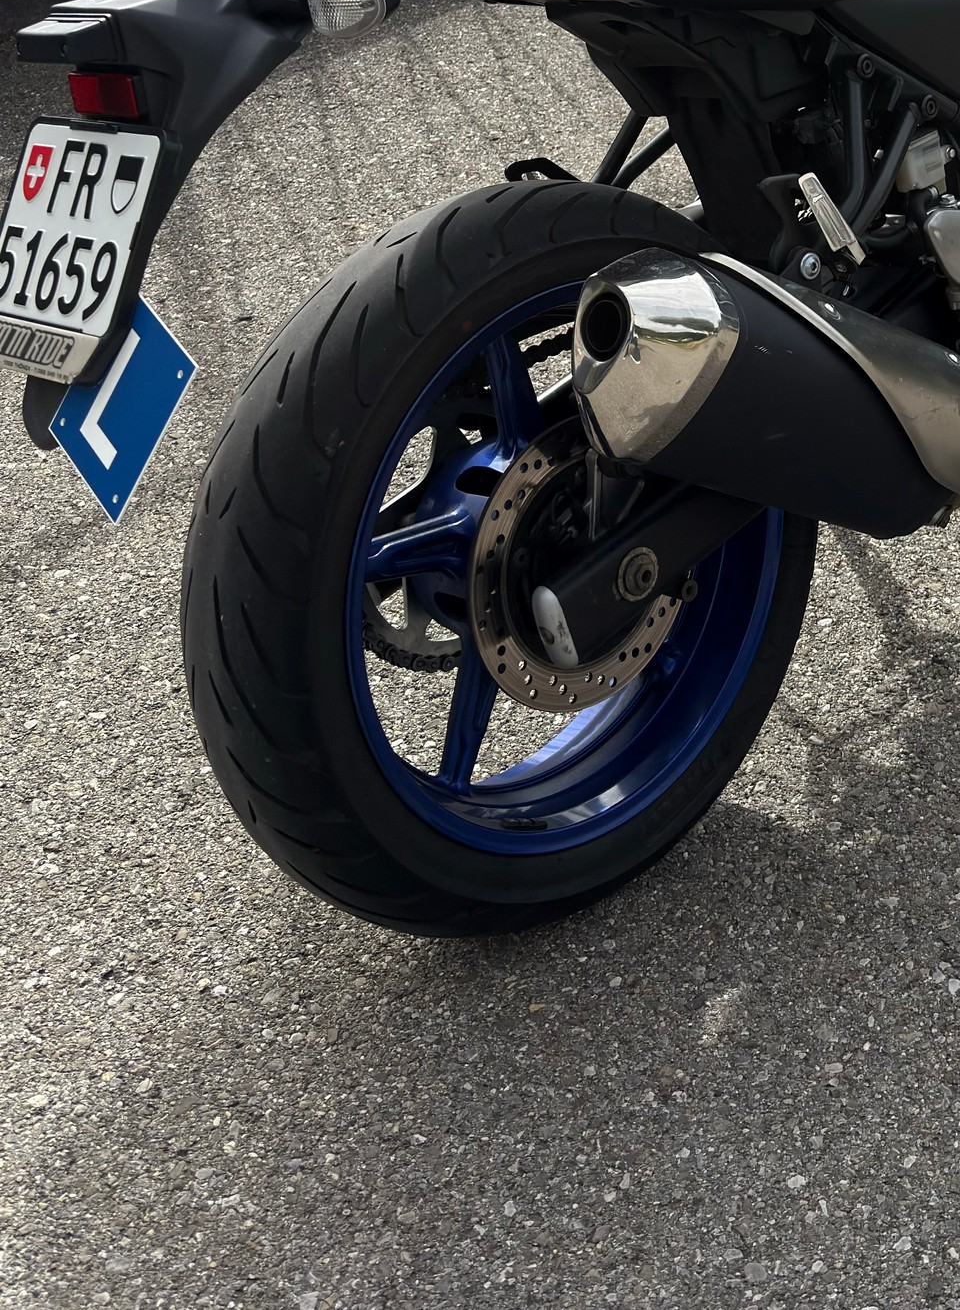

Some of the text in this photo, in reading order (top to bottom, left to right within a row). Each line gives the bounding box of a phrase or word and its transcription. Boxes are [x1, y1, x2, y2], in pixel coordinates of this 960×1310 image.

[47, 140, 108, 220] FR
[0, 225, 118, 321] 51659
[24, 330, 74, 368] RIDE
[80, 328, 141, 470] L
